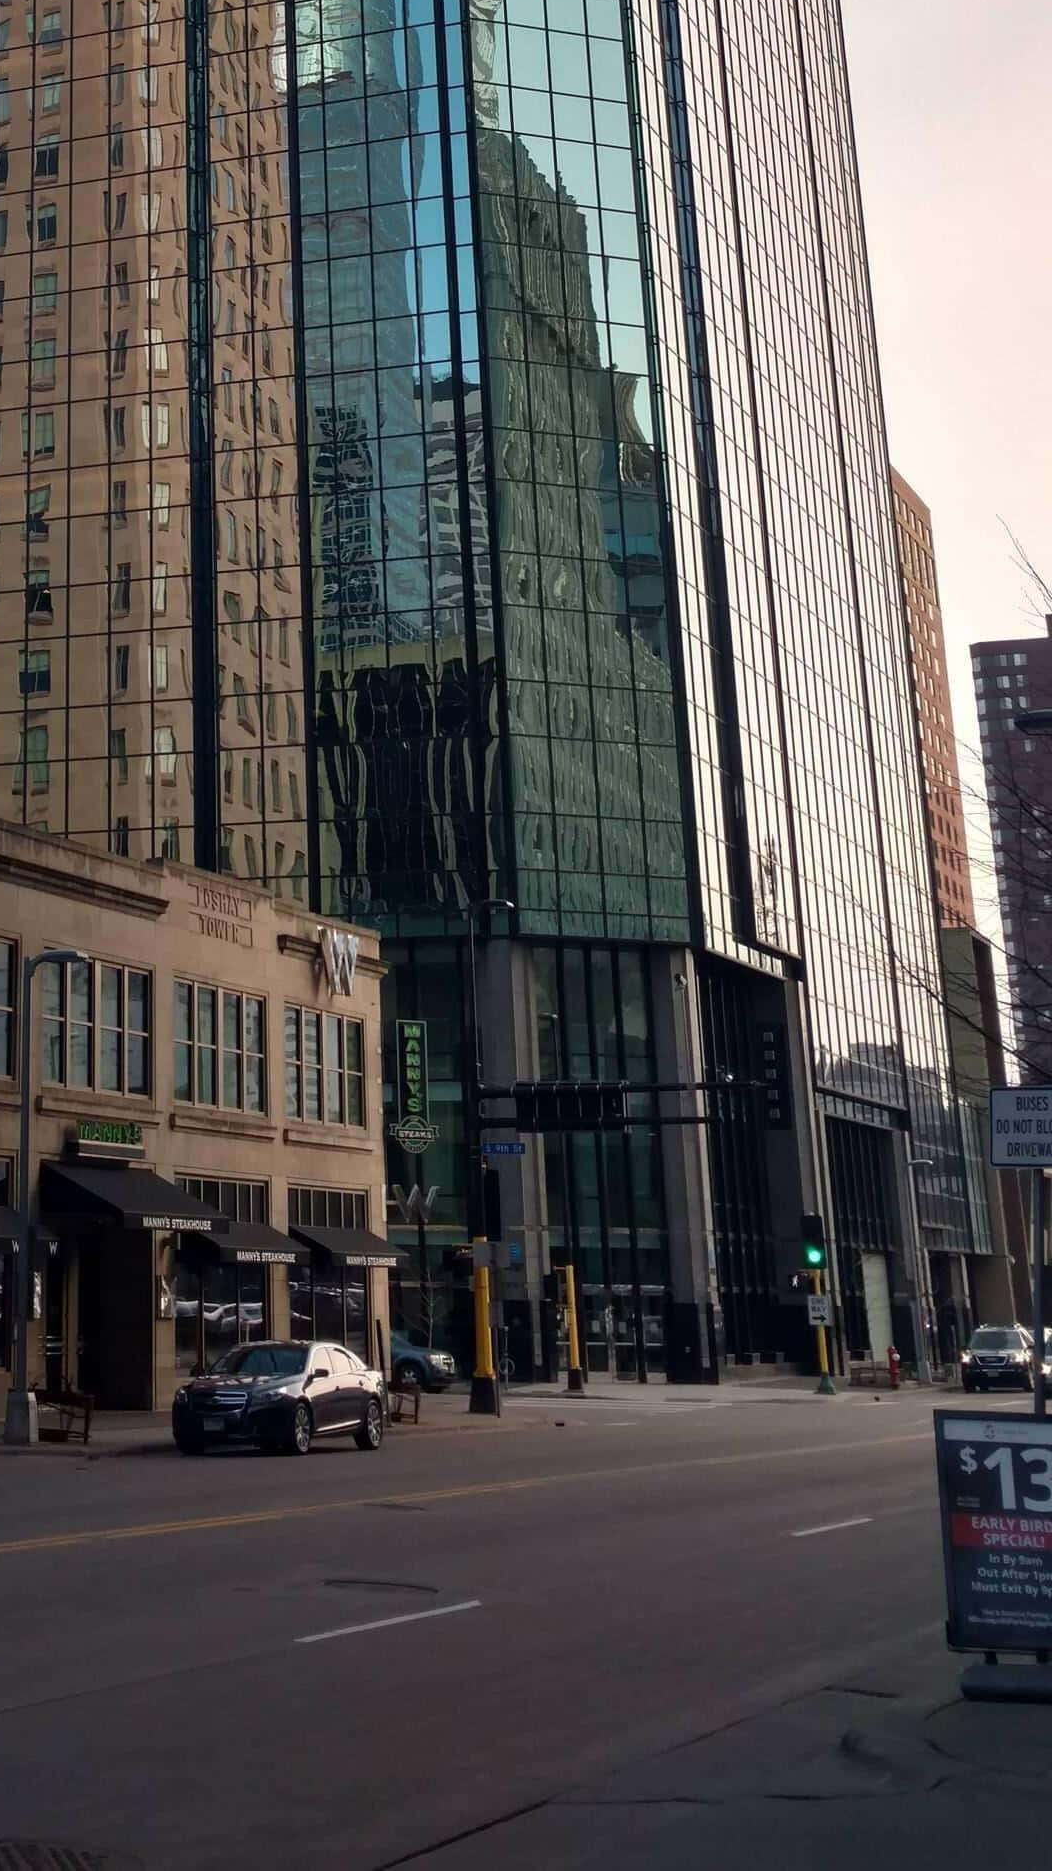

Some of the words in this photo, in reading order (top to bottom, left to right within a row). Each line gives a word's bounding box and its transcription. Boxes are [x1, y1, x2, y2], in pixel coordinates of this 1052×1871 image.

[198, 886, 241, 918] FOSHAY
[198, 915, 240, 945] TOWER
[316, 925, 360, 998] W
[404, 1024, 422, 1112] MANNY'S
[1015, 1096, 1050, 1112] BUSES
[996, 1119, 1011, 1134] DO
[1012, 1119, 1033, 1134] NOT
[1006, 1142, 1052, 1157] DRIVEWA
[391, 1183, 442, 1224] W
[142, 1216, 170, 1229] MANNY'S
[171, 1219, 212, 1231] STEAKHOUSE
[11, 1239, 20, 1253] W
[48, 1241, 59, 1256] W
[236, 1250, 260, 1262] MANNY'S
[261, 1252, 296, 1263] STEAKHOUSE
[346, 1255, 367, 1266] MANNY'S
[367, 1257, 397, 1266] STEAKHOUSE
[971, 1516, 1016, 1532] EARLY
[1019, 1518, 1052, 1534] BIRD
[982, 1532, 1045, 1549] SPECIAL!
[988, 1553, 1000, 1564] In
[1002, 1554, 1017, 1566] By
[977, 1567, 998, 1579] Out
[1002, 1568, 1030, 1580] After
[971, 1581, 999, 1593] Must
[1002, 1583, 1023, 1595] Exit
[1025, 1585, 1039, 1598] By
